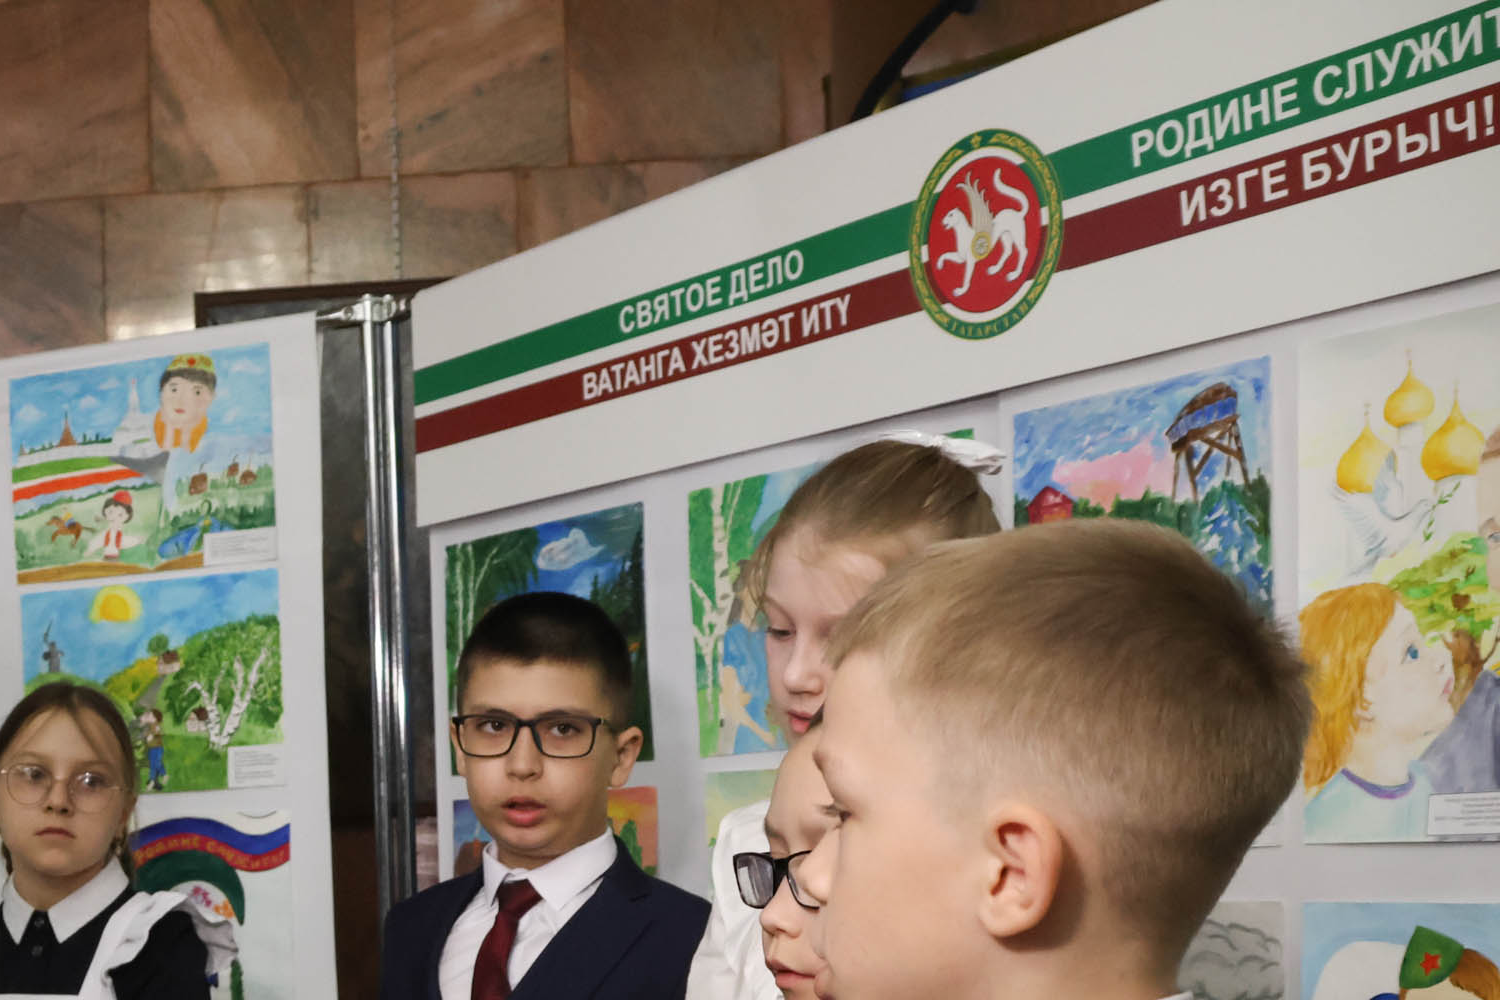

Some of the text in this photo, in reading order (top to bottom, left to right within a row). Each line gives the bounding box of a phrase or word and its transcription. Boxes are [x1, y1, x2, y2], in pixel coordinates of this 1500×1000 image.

[582, 346, 686, 401] ВАТАНГА
[690, 312, 796, 370] ХЕЗМӘТ
[1179, 159, 1290, 227] ИЗГЕ
[1301, 94, 1496, 191] БУРЫЧ!
[618, 275, 722, 334] СВЯТОЕ
[728, 249, 805, 305] ДЕЛО
[1130, 78, 1301, 168] РОДИНЕ
